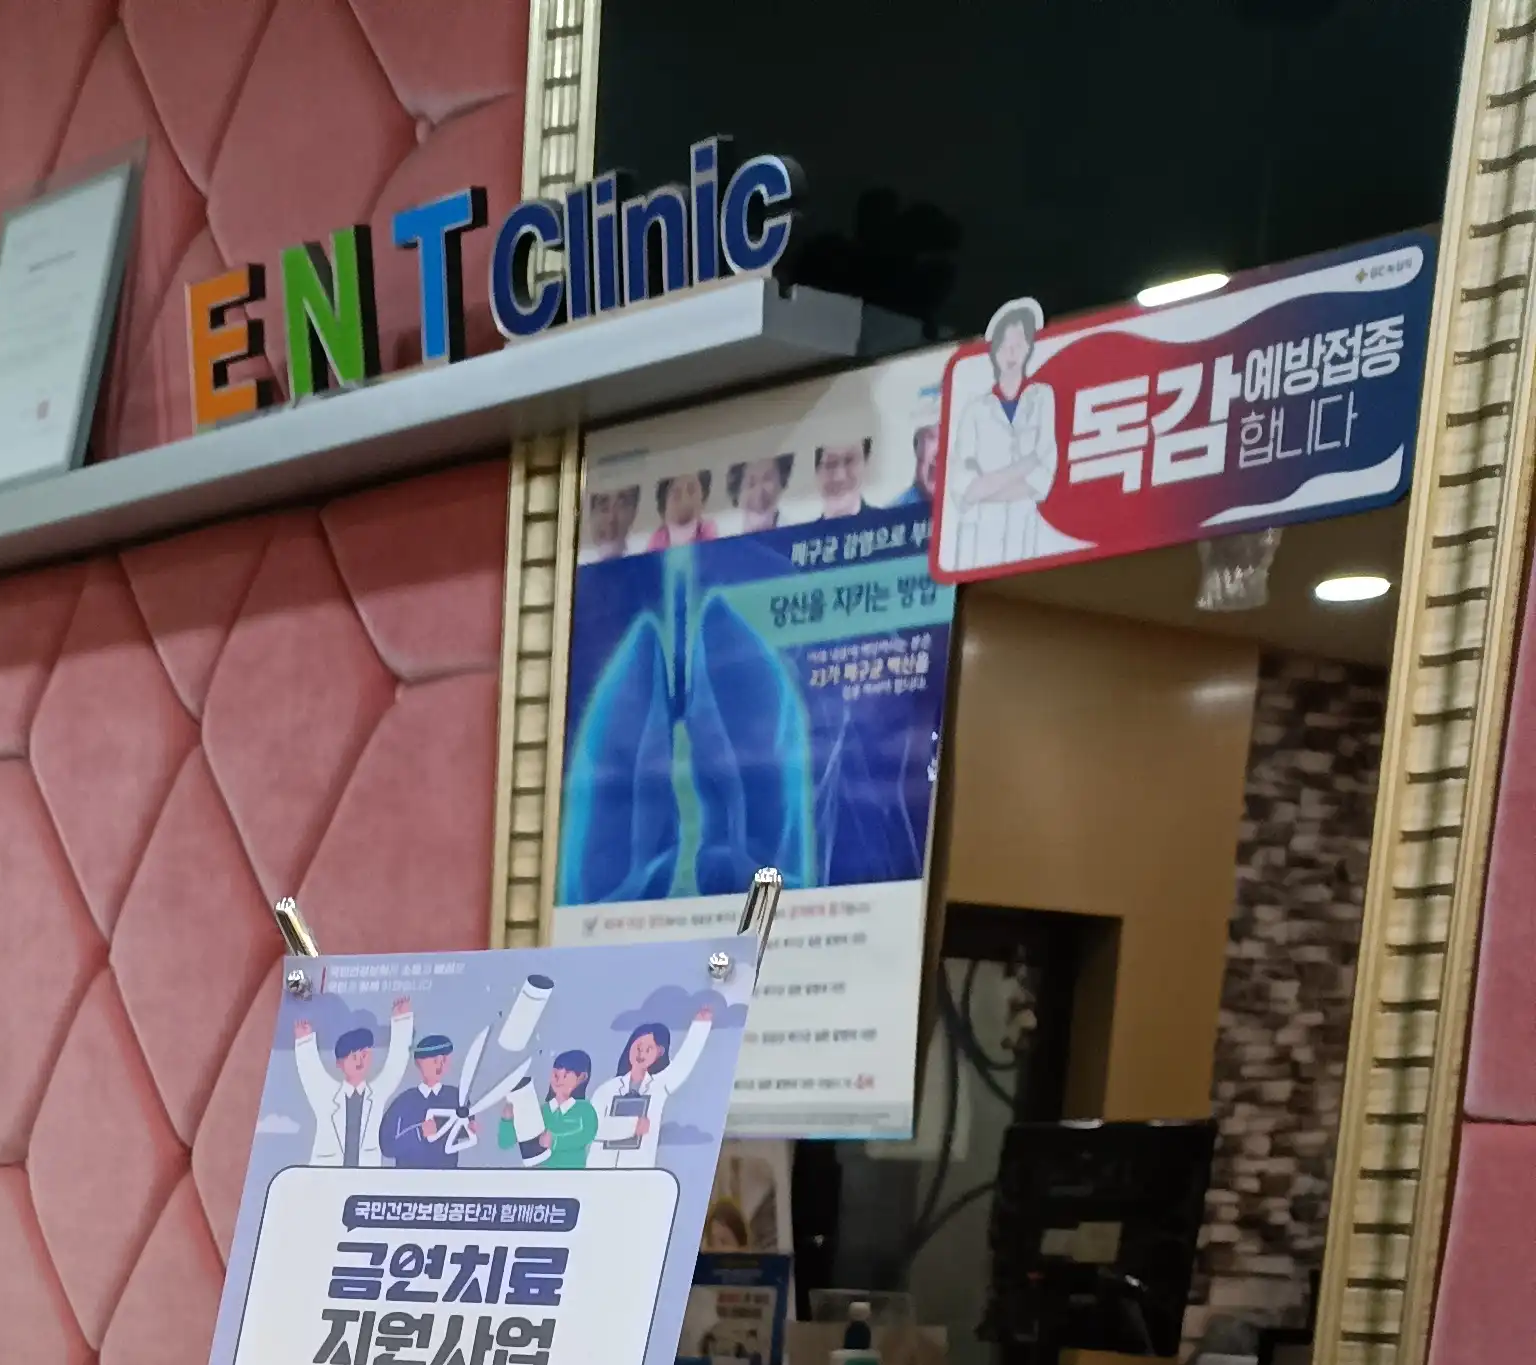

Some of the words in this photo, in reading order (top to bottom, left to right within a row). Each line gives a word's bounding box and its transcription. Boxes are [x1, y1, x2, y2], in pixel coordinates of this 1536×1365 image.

[489, 134, 795, 338] Clinic
[1067, 355, 1244, 493] 독감
[1243, 315, 1404, 405] 예방접종
[1238, 390, 1359, 468] 합니다
[354, 1200, 498, 1224] 국민건강보험공단과
[500, 1204, 567, 1225] 함께하는
[327, 1241, 570, 1306] 금연치료
